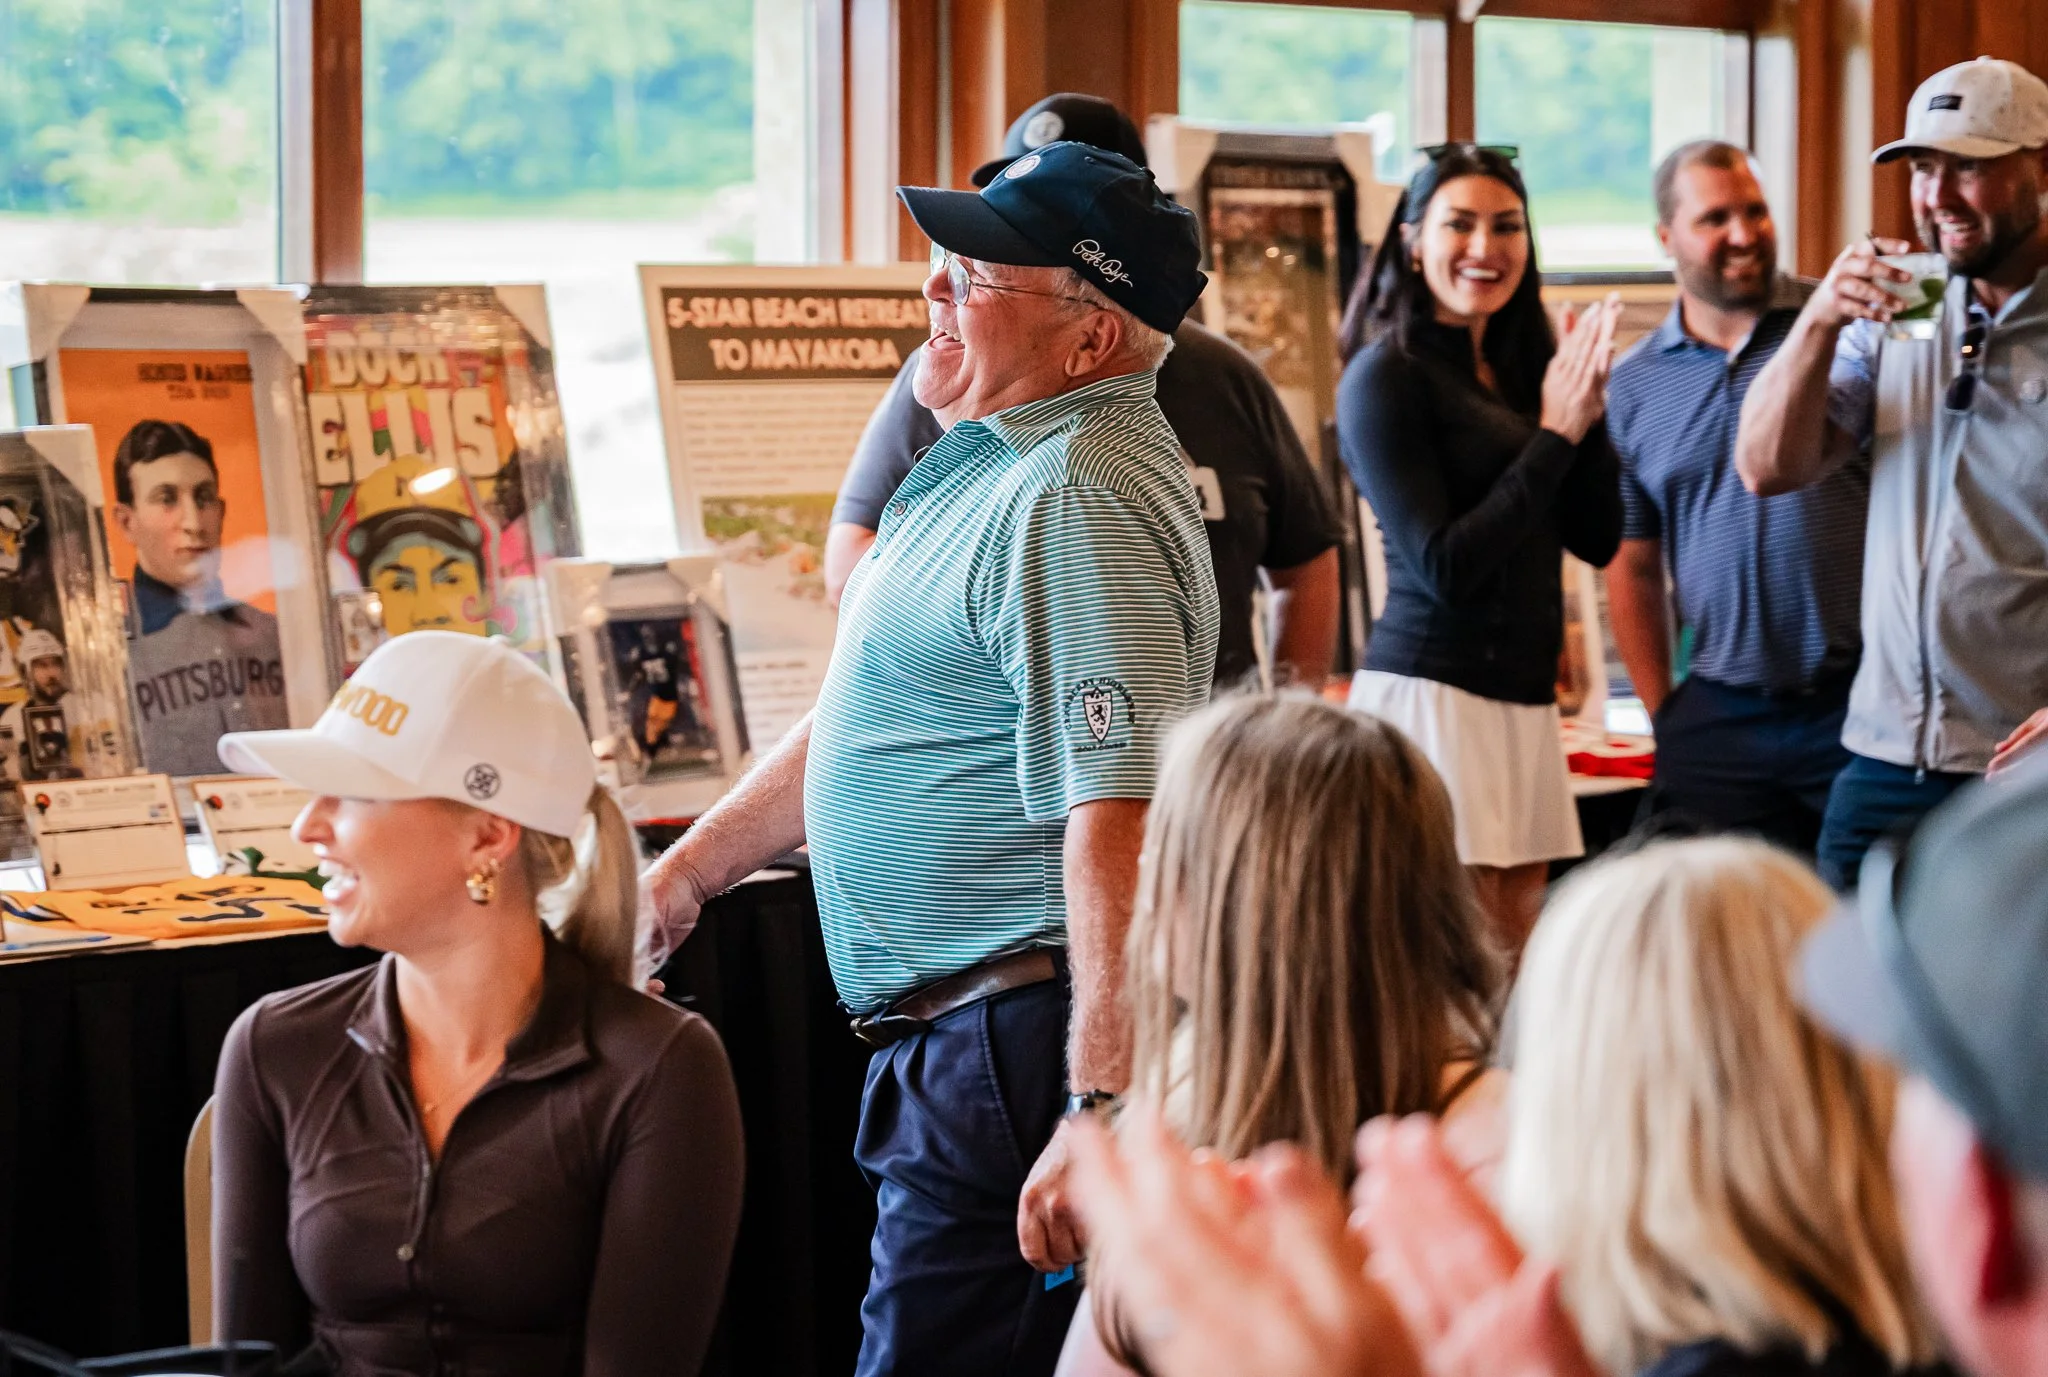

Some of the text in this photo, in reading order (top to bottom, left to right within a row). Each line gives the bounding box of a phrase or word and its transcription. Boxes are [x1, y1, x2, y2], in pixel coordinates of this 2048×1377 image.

[753, 297, 837, 329] BEACH
[708, 338, 902, 371] TO MAYAKOBA
[307, 387, 501, 488] ELLIS
